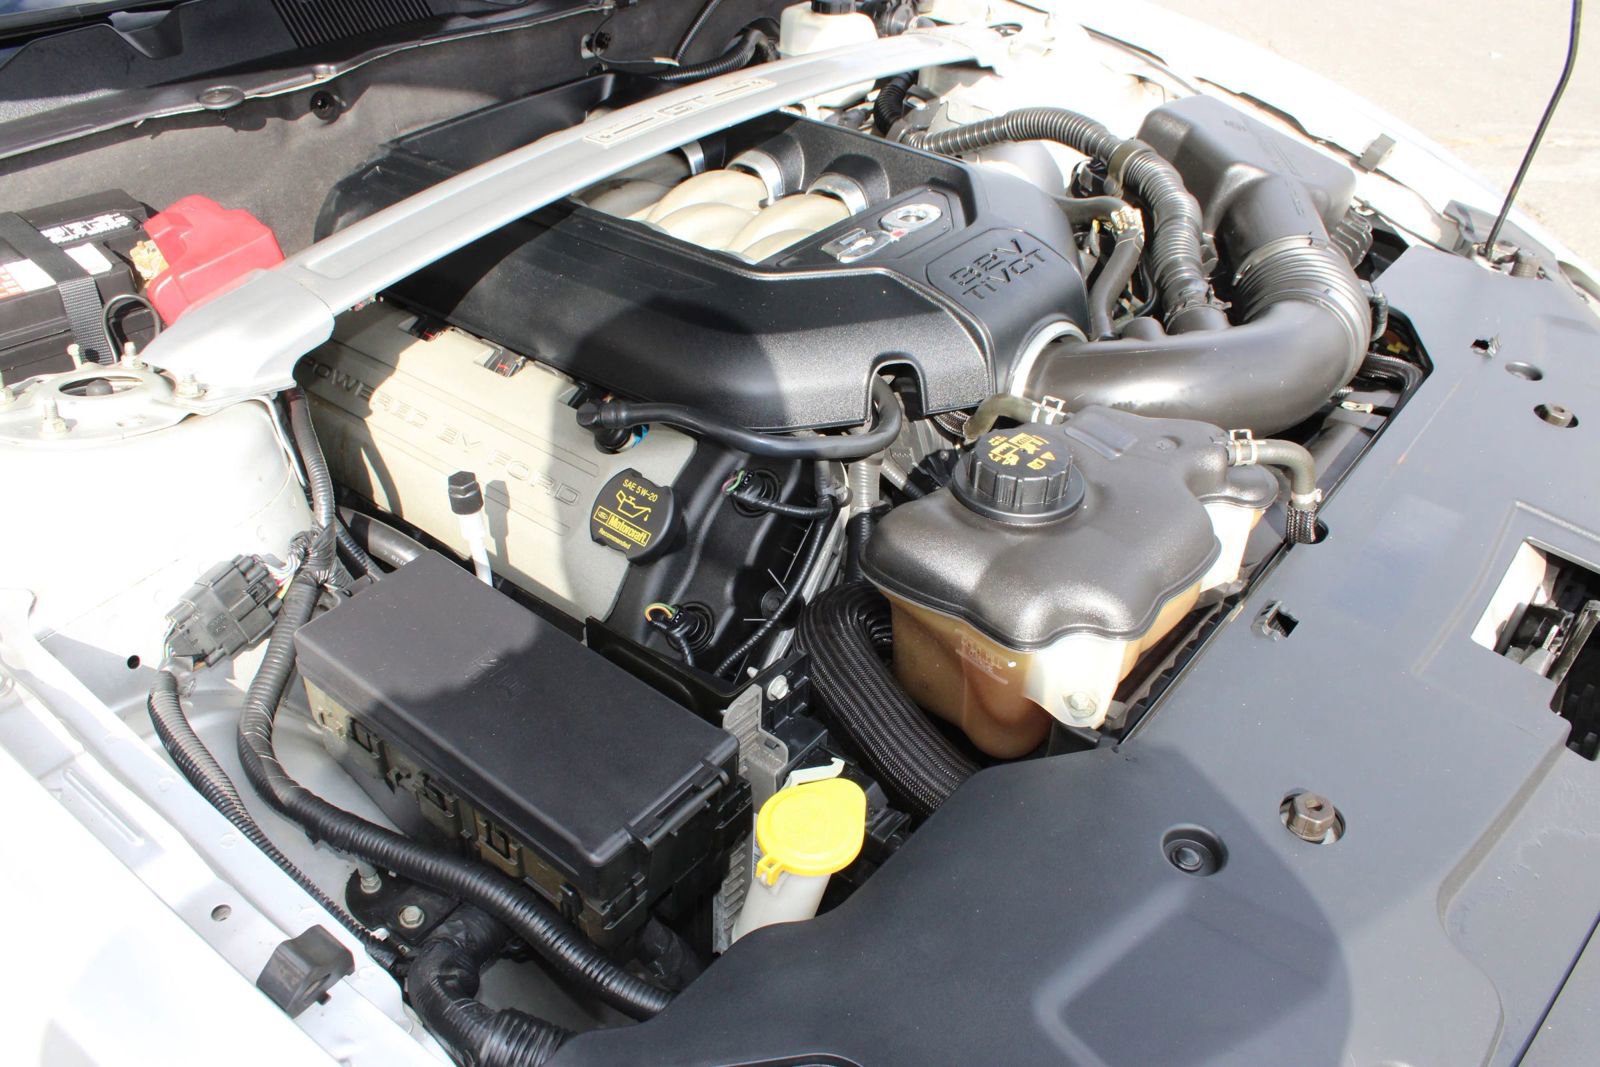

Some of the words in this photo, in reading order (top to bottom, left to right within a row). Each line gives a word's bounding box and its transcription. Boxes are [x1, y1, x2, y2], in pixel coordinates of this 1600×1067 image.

[821, 203, 943, 263] 5.0
[299, 356, 430, 430] POWERED
[436, 423, 481, 454] BY
[487, 448, 583, 507] FORD
[623, 479, 636, 491] SAE
[636, 486, 658, 502] 5W-20
[607, 515, 648, 544] Motorcraft
